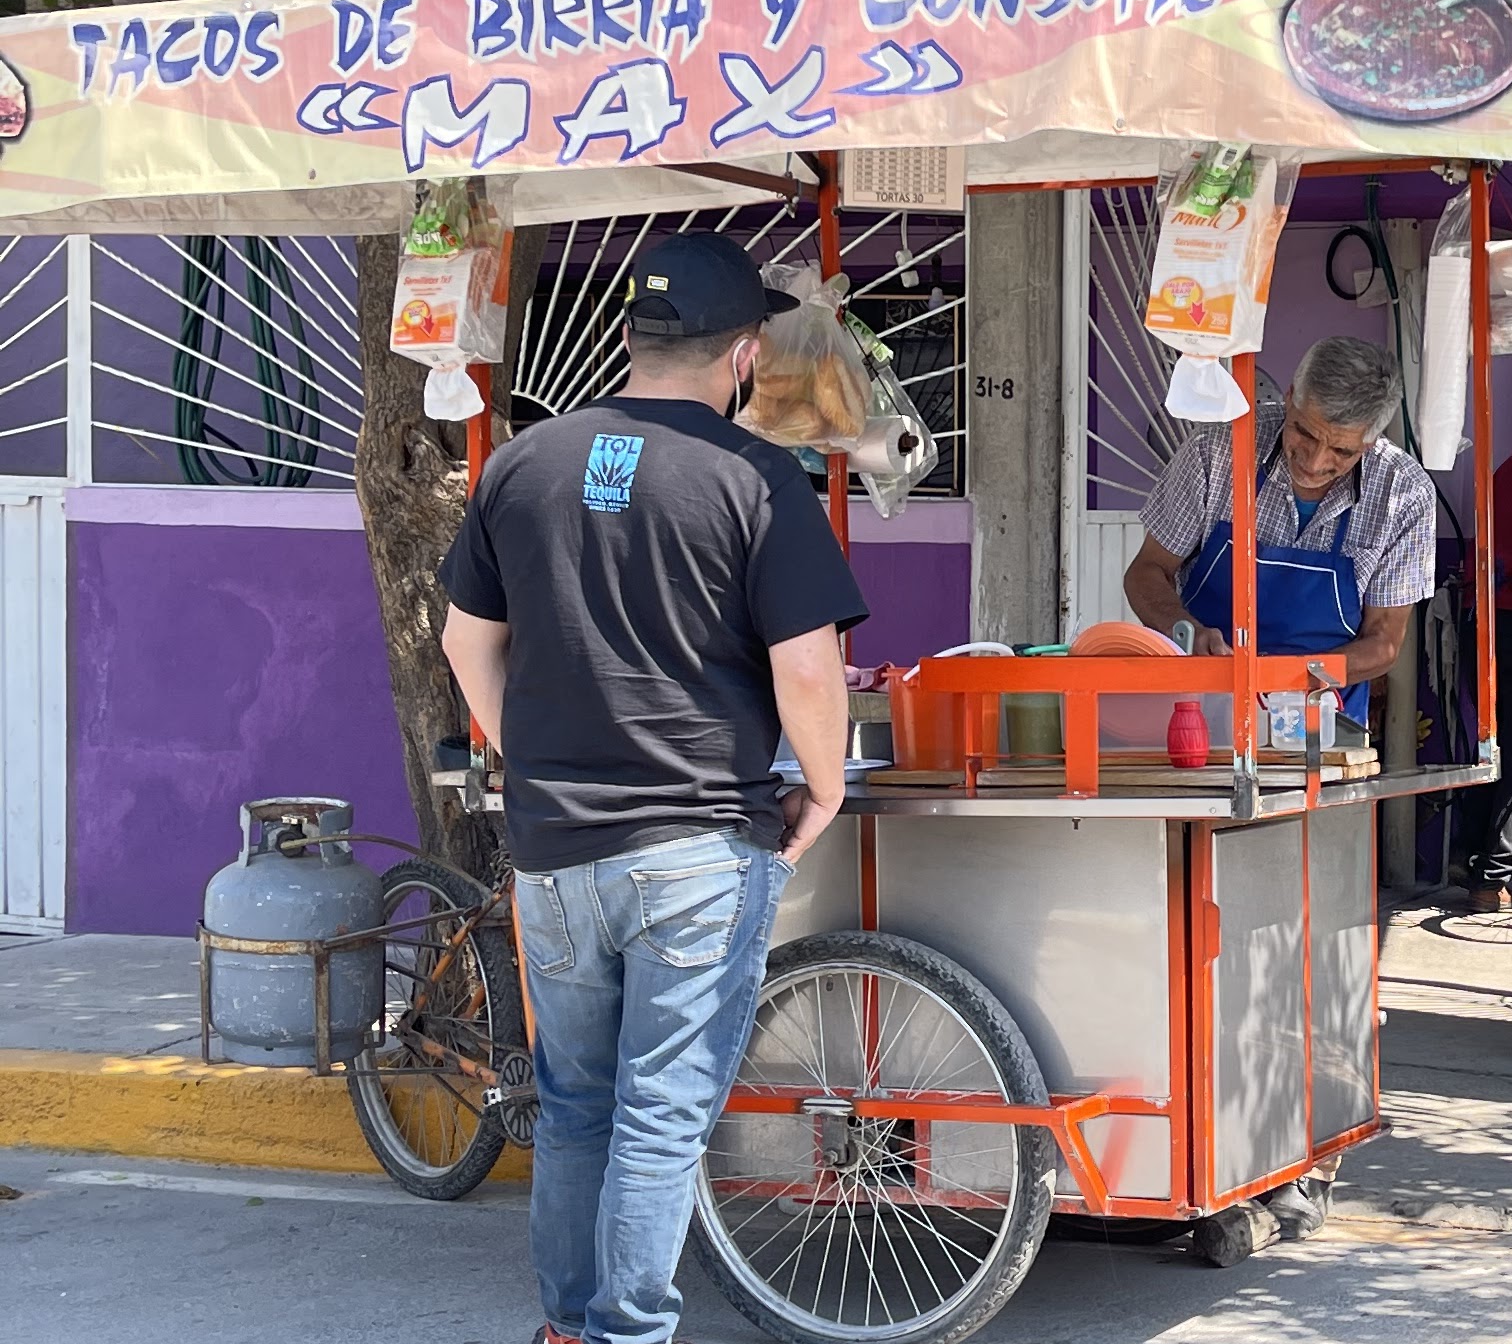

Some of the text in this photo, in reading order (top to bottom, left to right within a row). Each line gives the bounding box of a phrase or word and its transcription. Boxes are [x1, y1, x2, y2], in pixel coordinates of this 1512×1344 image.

[72, 11, 281, 94] TACOS
[875, 191, 925, 204] TORTAS 30
[975, 376, 1014, 400] 31-8
[583, 484, 631, 503] TEQUILA
